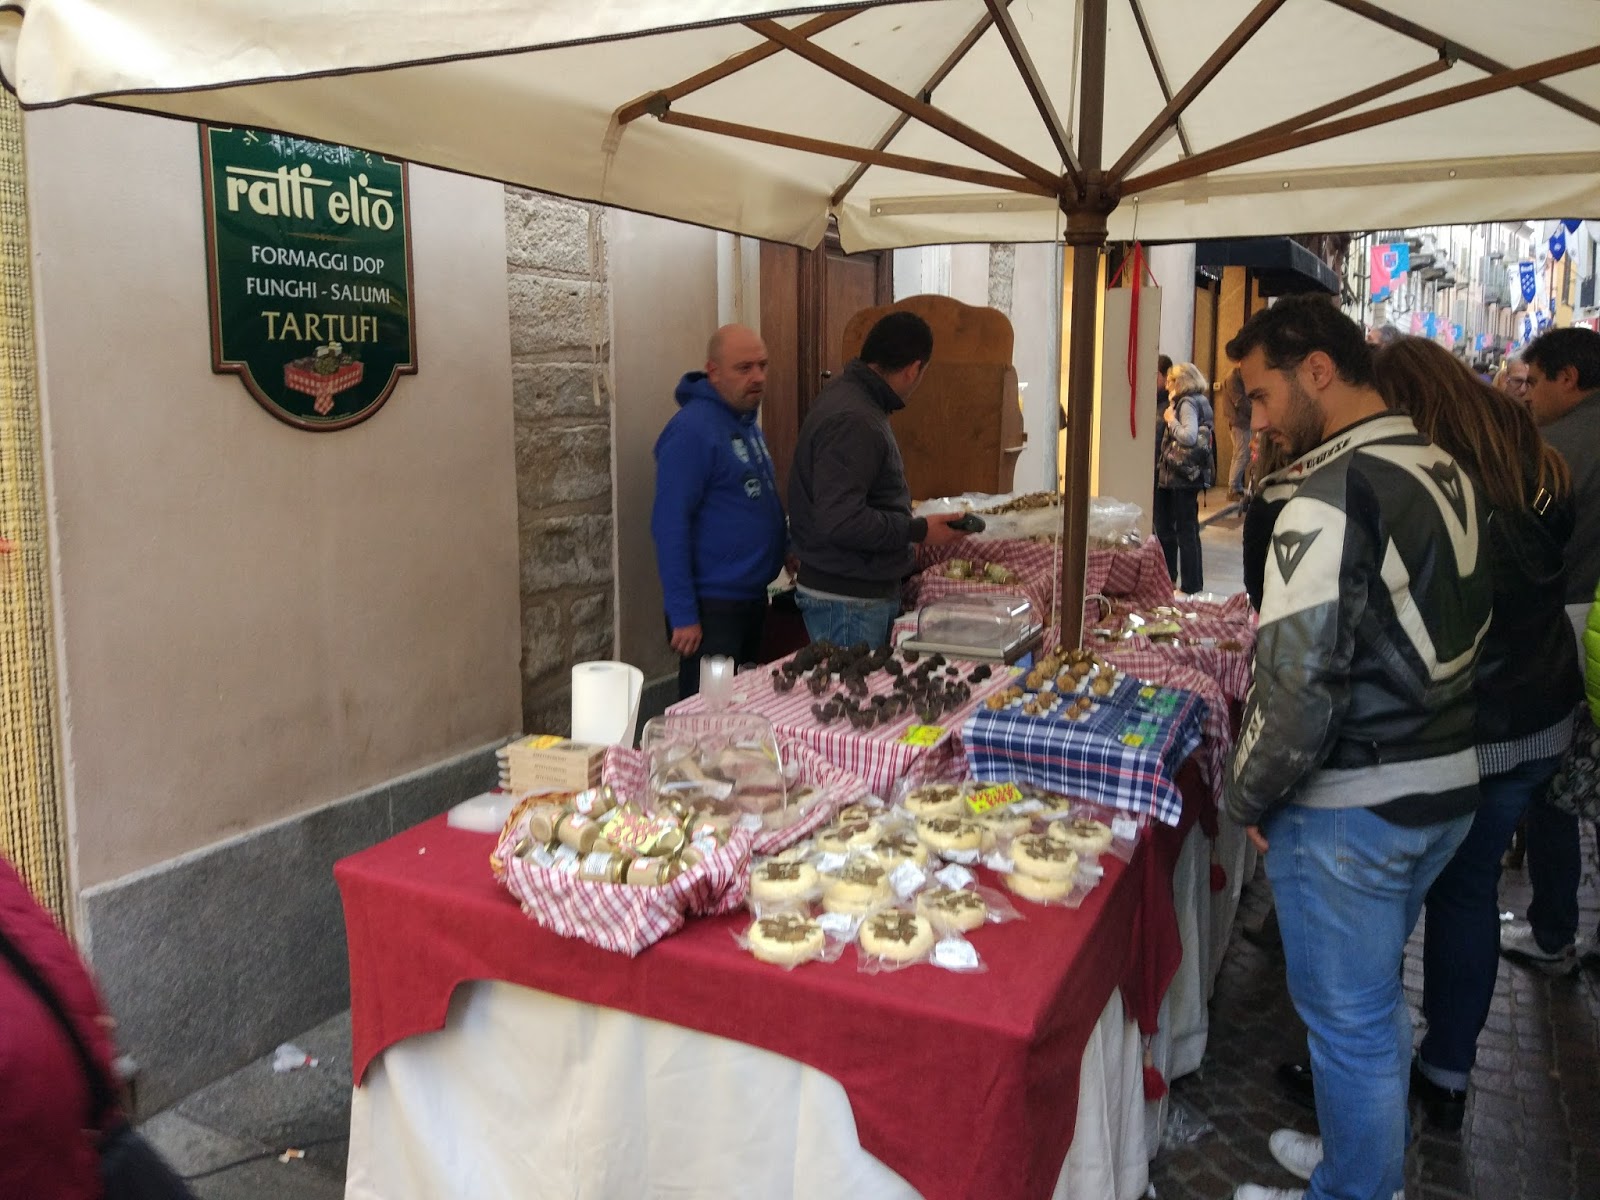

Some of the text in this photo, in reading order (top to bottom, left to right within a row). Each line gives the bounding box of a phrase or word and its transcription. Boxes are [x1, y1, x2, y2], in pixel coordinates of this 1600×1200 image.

[225, 164, 394, 230] ratti elio
[252, 246, 384, 273] FORMAGGI DOP
[247, 278, 317, 298] FUNGHI
[332, 284, 390, 304] SALUMI
[261, 312, 378, 342] TARTUFI
